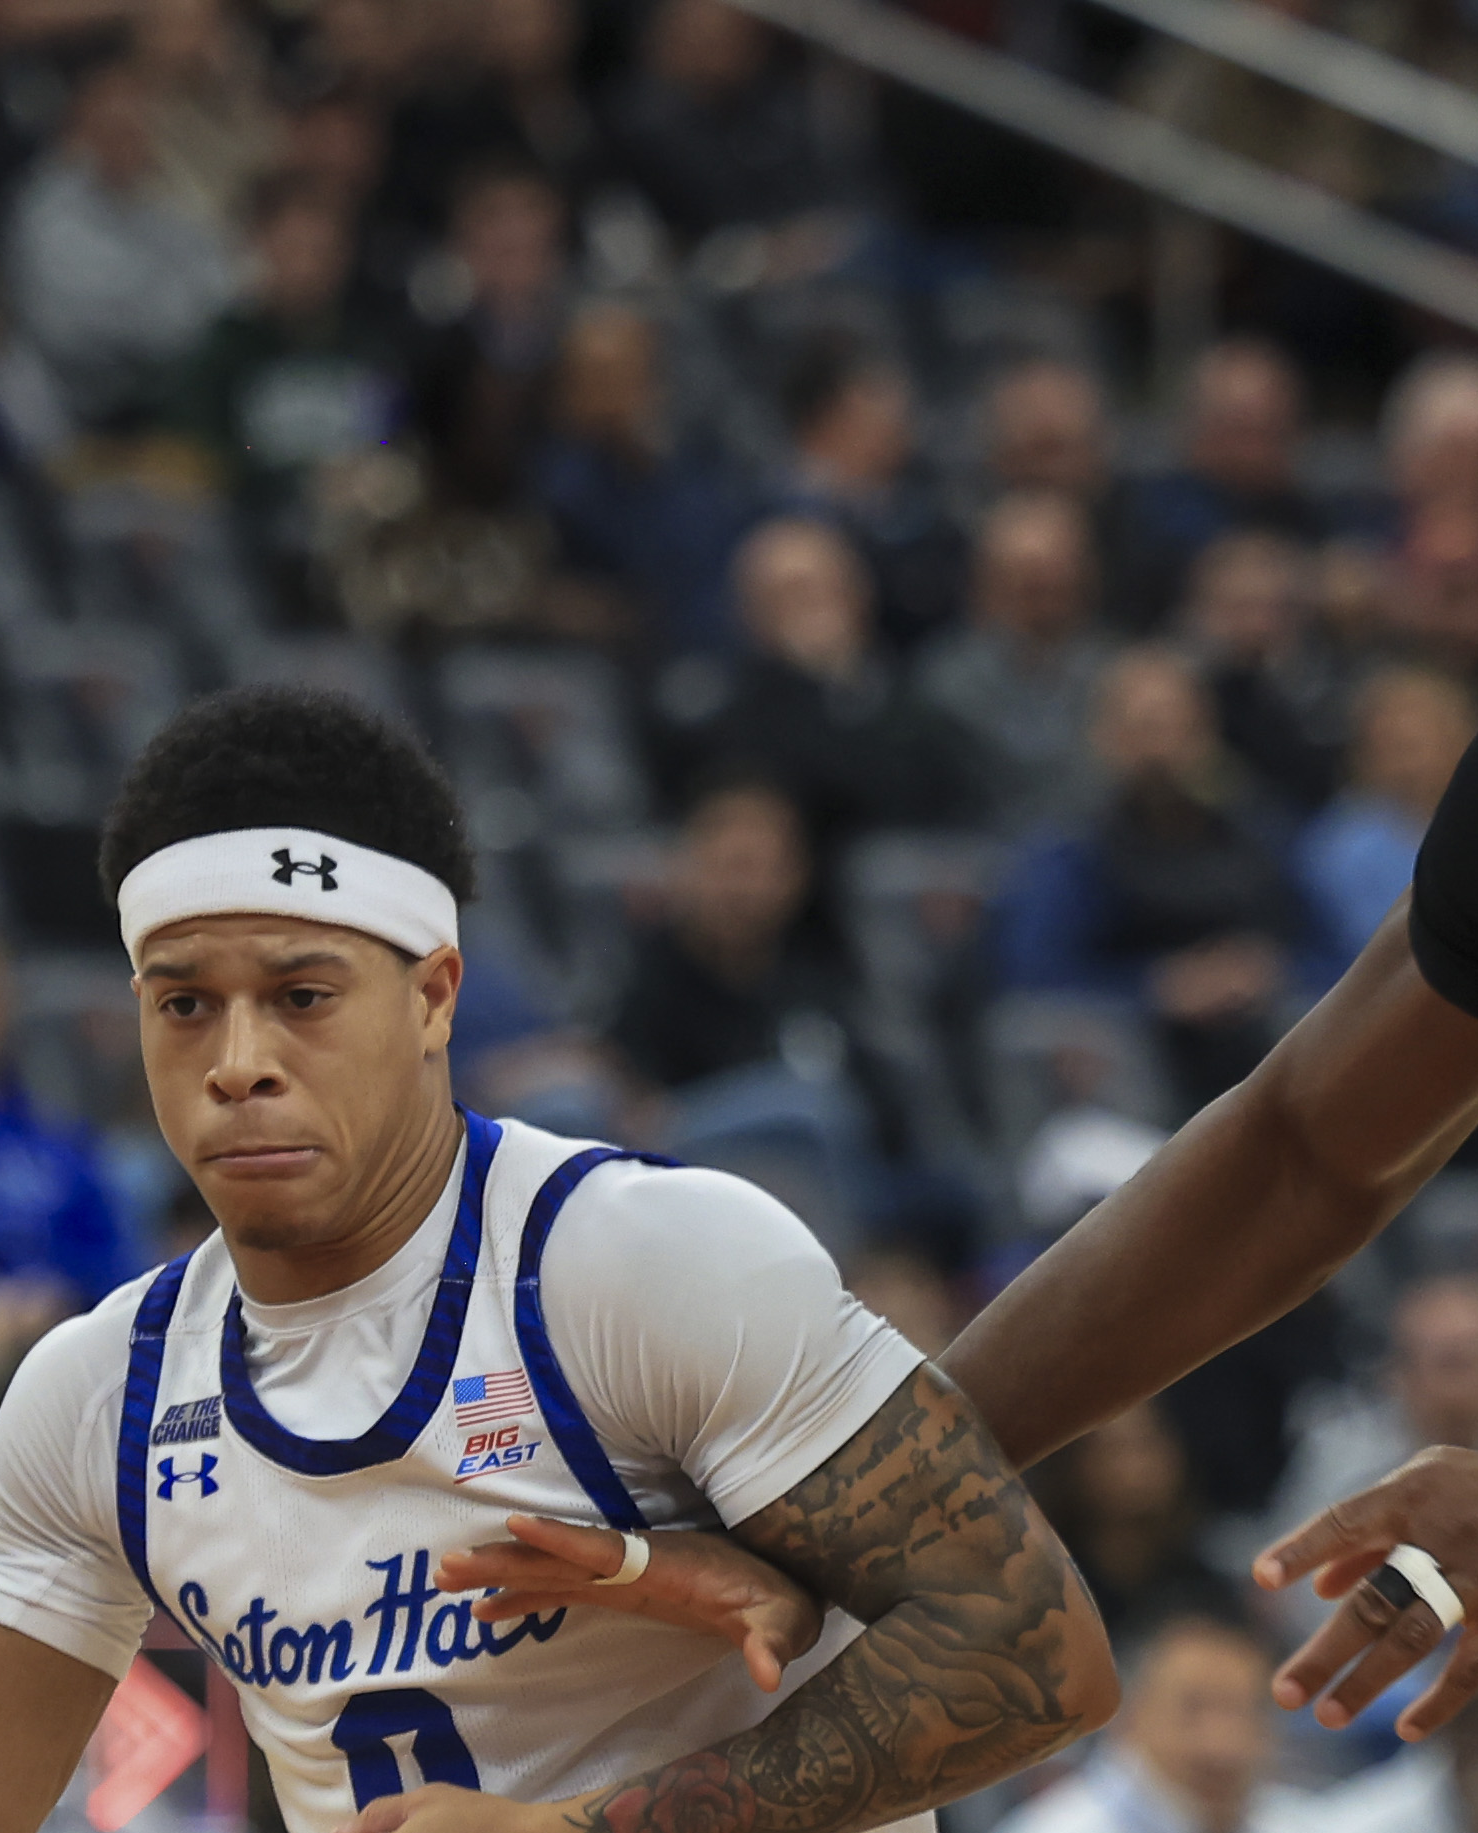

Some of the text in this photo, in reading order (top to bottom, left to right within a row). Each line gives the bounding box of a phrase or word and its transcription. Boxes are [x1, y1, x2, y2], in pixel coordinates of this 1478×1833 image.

[163, 1394, 222, 1423] BE THE
[152, 1414, 221, 1446] CHANGE
[463, 1425, 520, 1456] BIG
[456, 1441, 542, 1476] EAST
